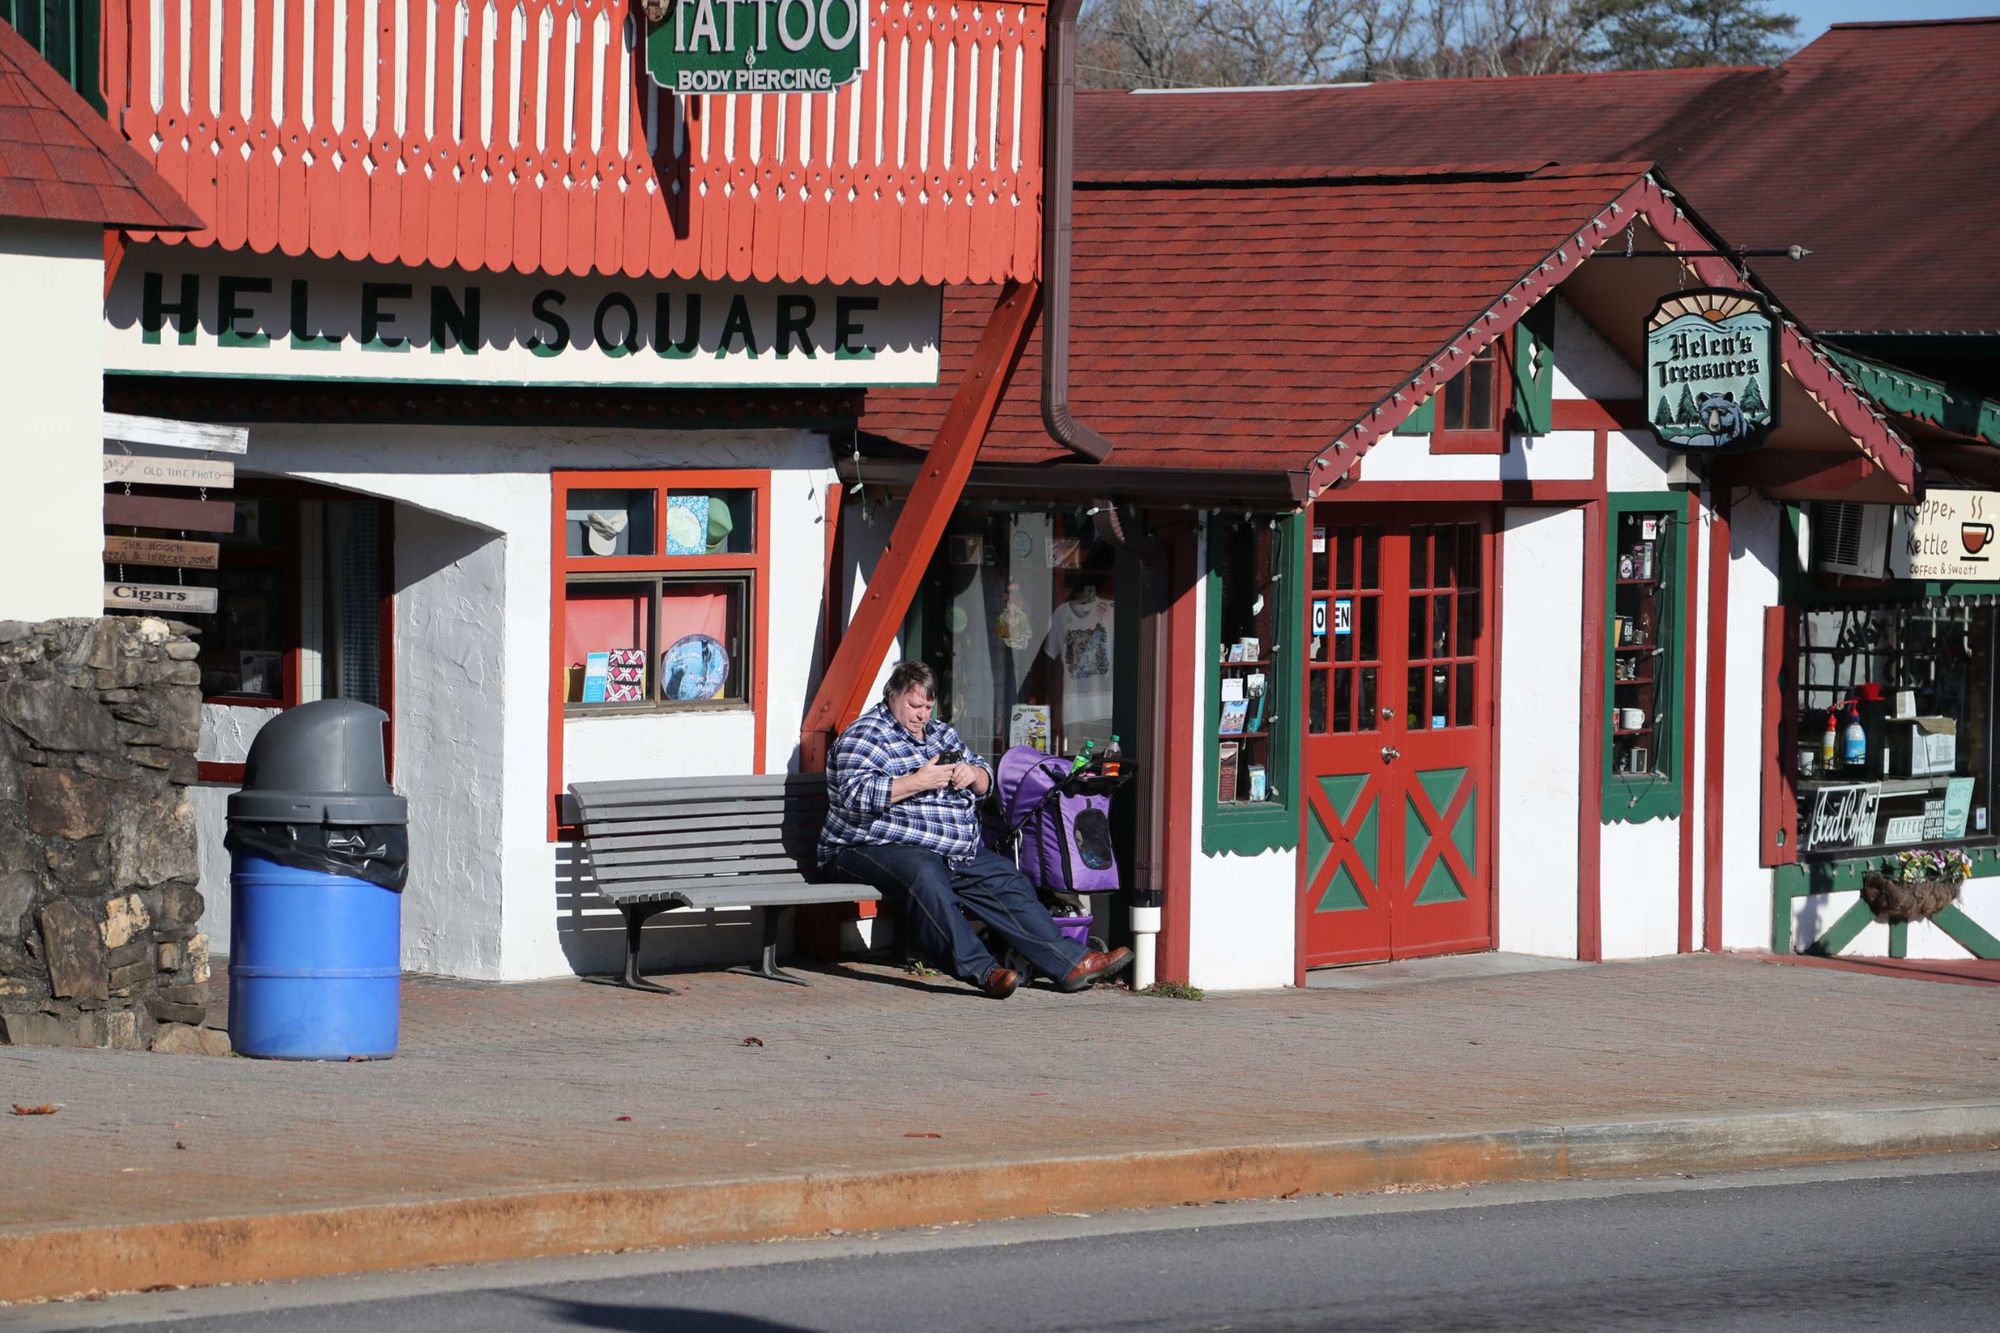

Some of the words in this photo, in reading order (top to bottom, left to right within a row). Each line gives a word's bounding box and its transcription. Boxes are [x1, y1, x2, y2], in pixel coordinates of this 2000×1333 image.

[670, 0, 858, 52] TATTOO
[678, 70, 732, 91] BODY
[735, 68, 832, 91] PIERCING
[142, 272, 481, 356] HELEN
[526, 288, 880, 361] SQUARE
[1668, 331, 1753, 361] Helen's
[1653, 358, 1760, 388] Treasures
[143, 466, 163, 477] OLD
[166, 467, 188, 478] TIME
[191, 468, 221, 480] PHOTO
[1903, 500, 1956, 526] Kopper
[1906, 531, 1949, 557] Kettle
[1940, 562, 1946, 575] &
[112, 585, 187, 603] Cigars
[1315, 606, 1350, 629] OEN
[1924, 800, 1945, 810] INSTANT
[1924, 809, 1944, 819] HUMAN
[1811, 790, 1846, 845] Iced
[1841, 787, 1876, 847] Coffee
[1924, 818, 1935, 828] JUST
[1934, 818, 1944, 828] ADD
[1923, 827, 1944, 840] COFFEE
